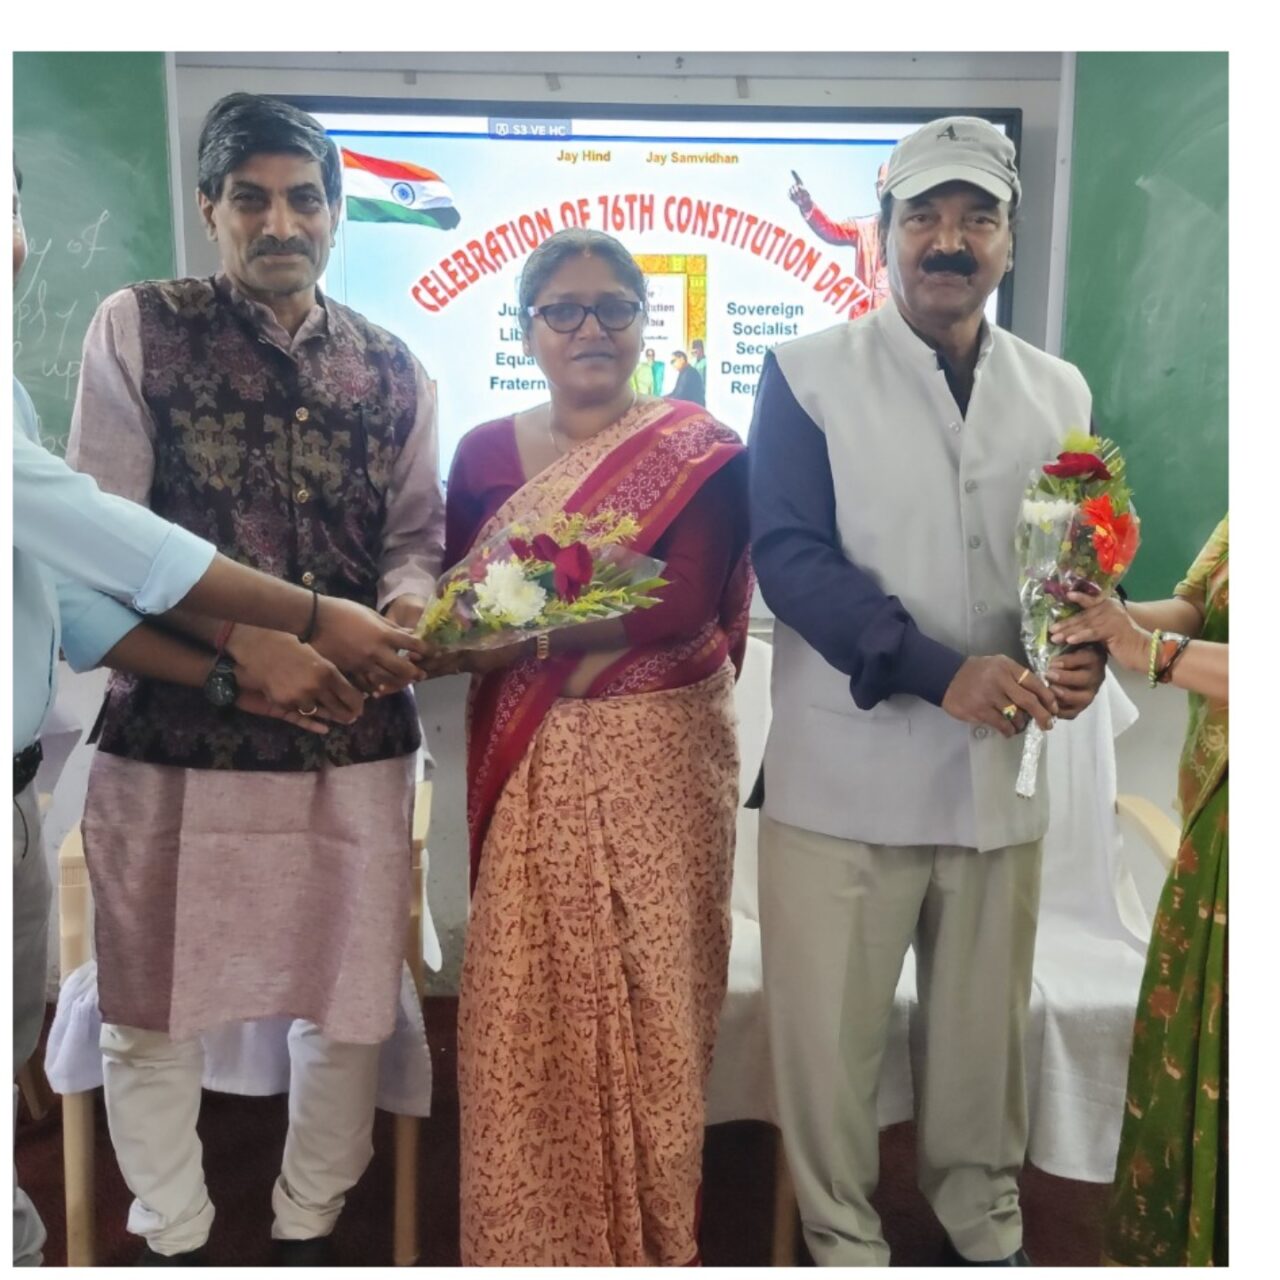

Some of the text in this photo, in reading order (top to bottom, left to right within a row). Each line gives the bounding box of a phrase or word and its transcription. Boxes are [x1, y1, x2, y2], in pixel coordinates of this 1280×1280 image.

[512, 124, 567, 137] S3 VE HC
[557, 150, 611, 165] Jay Hind
[646, 152, 739, 166] Jay Samvidhan
[411, 194, 870, 315] CELEBRATION OF 76TH CONSTITUTION DAY
[727, 302, 804, 318] Sovereign
[733, 322, 798, 335] Socialist
[496, 352, 535, 369] Equa
[721, 361, 763, 374] Demo
[489, 376, 546, 390] Fratern
